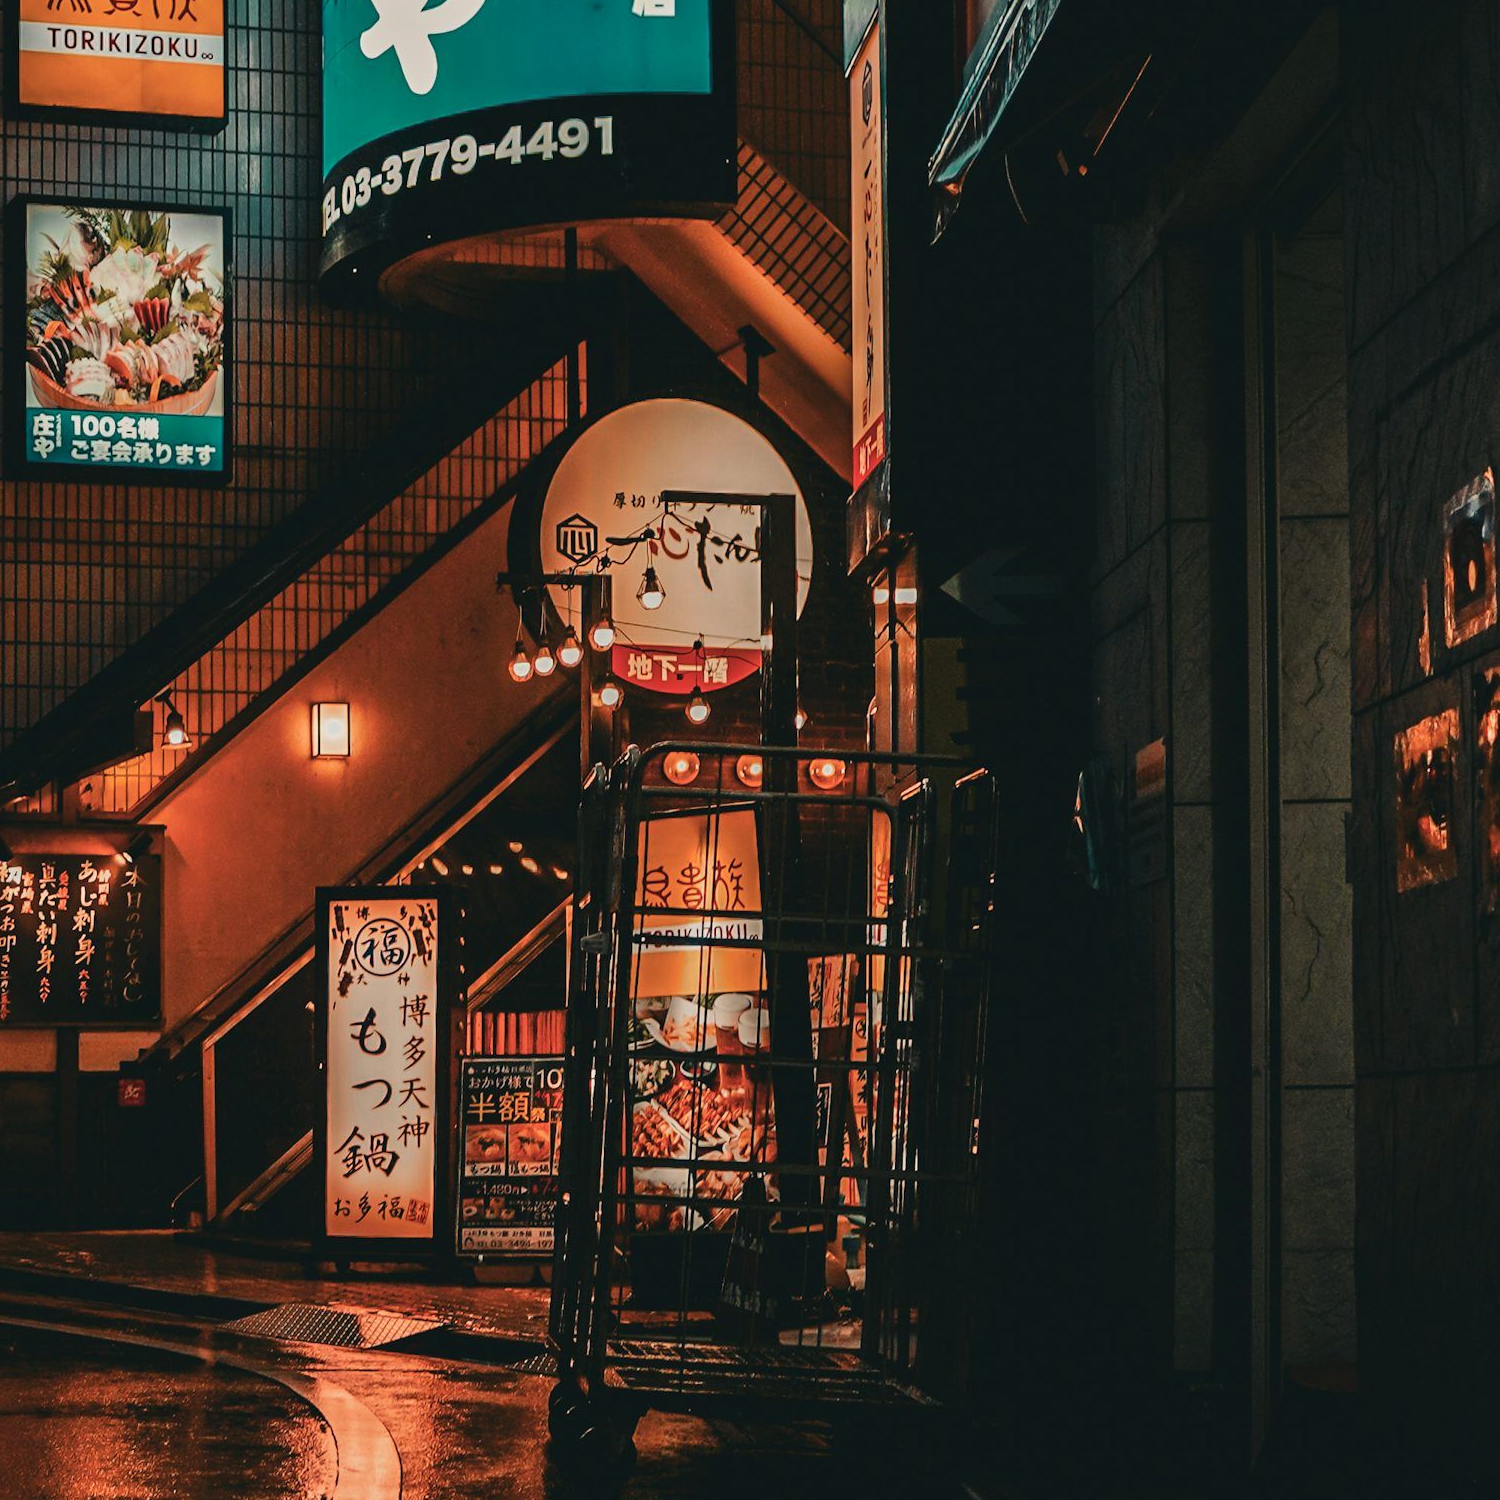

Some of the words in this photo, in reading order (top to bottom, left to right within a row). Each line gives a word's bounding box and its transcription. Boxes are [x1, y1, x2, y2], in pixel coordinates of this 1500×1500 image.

[47, 28, 198, 59] TORIKIZOKU
[342, 115, 614, 217] 03-3779-4491
[33, 413, 55, 459] 庄や
[70, 415, 160, 440] 100名様
[70, 439, 216, 466] ご宴会承ります
[627, 653, 729, 684] 地下一階
[72, 860, 99, 966] あじ刺身
[334, 1007, 400, 1178] もつ鍋
[398, 996, 431, 1150] 博多天神
[334, 1191, 405, 1224] お多福
